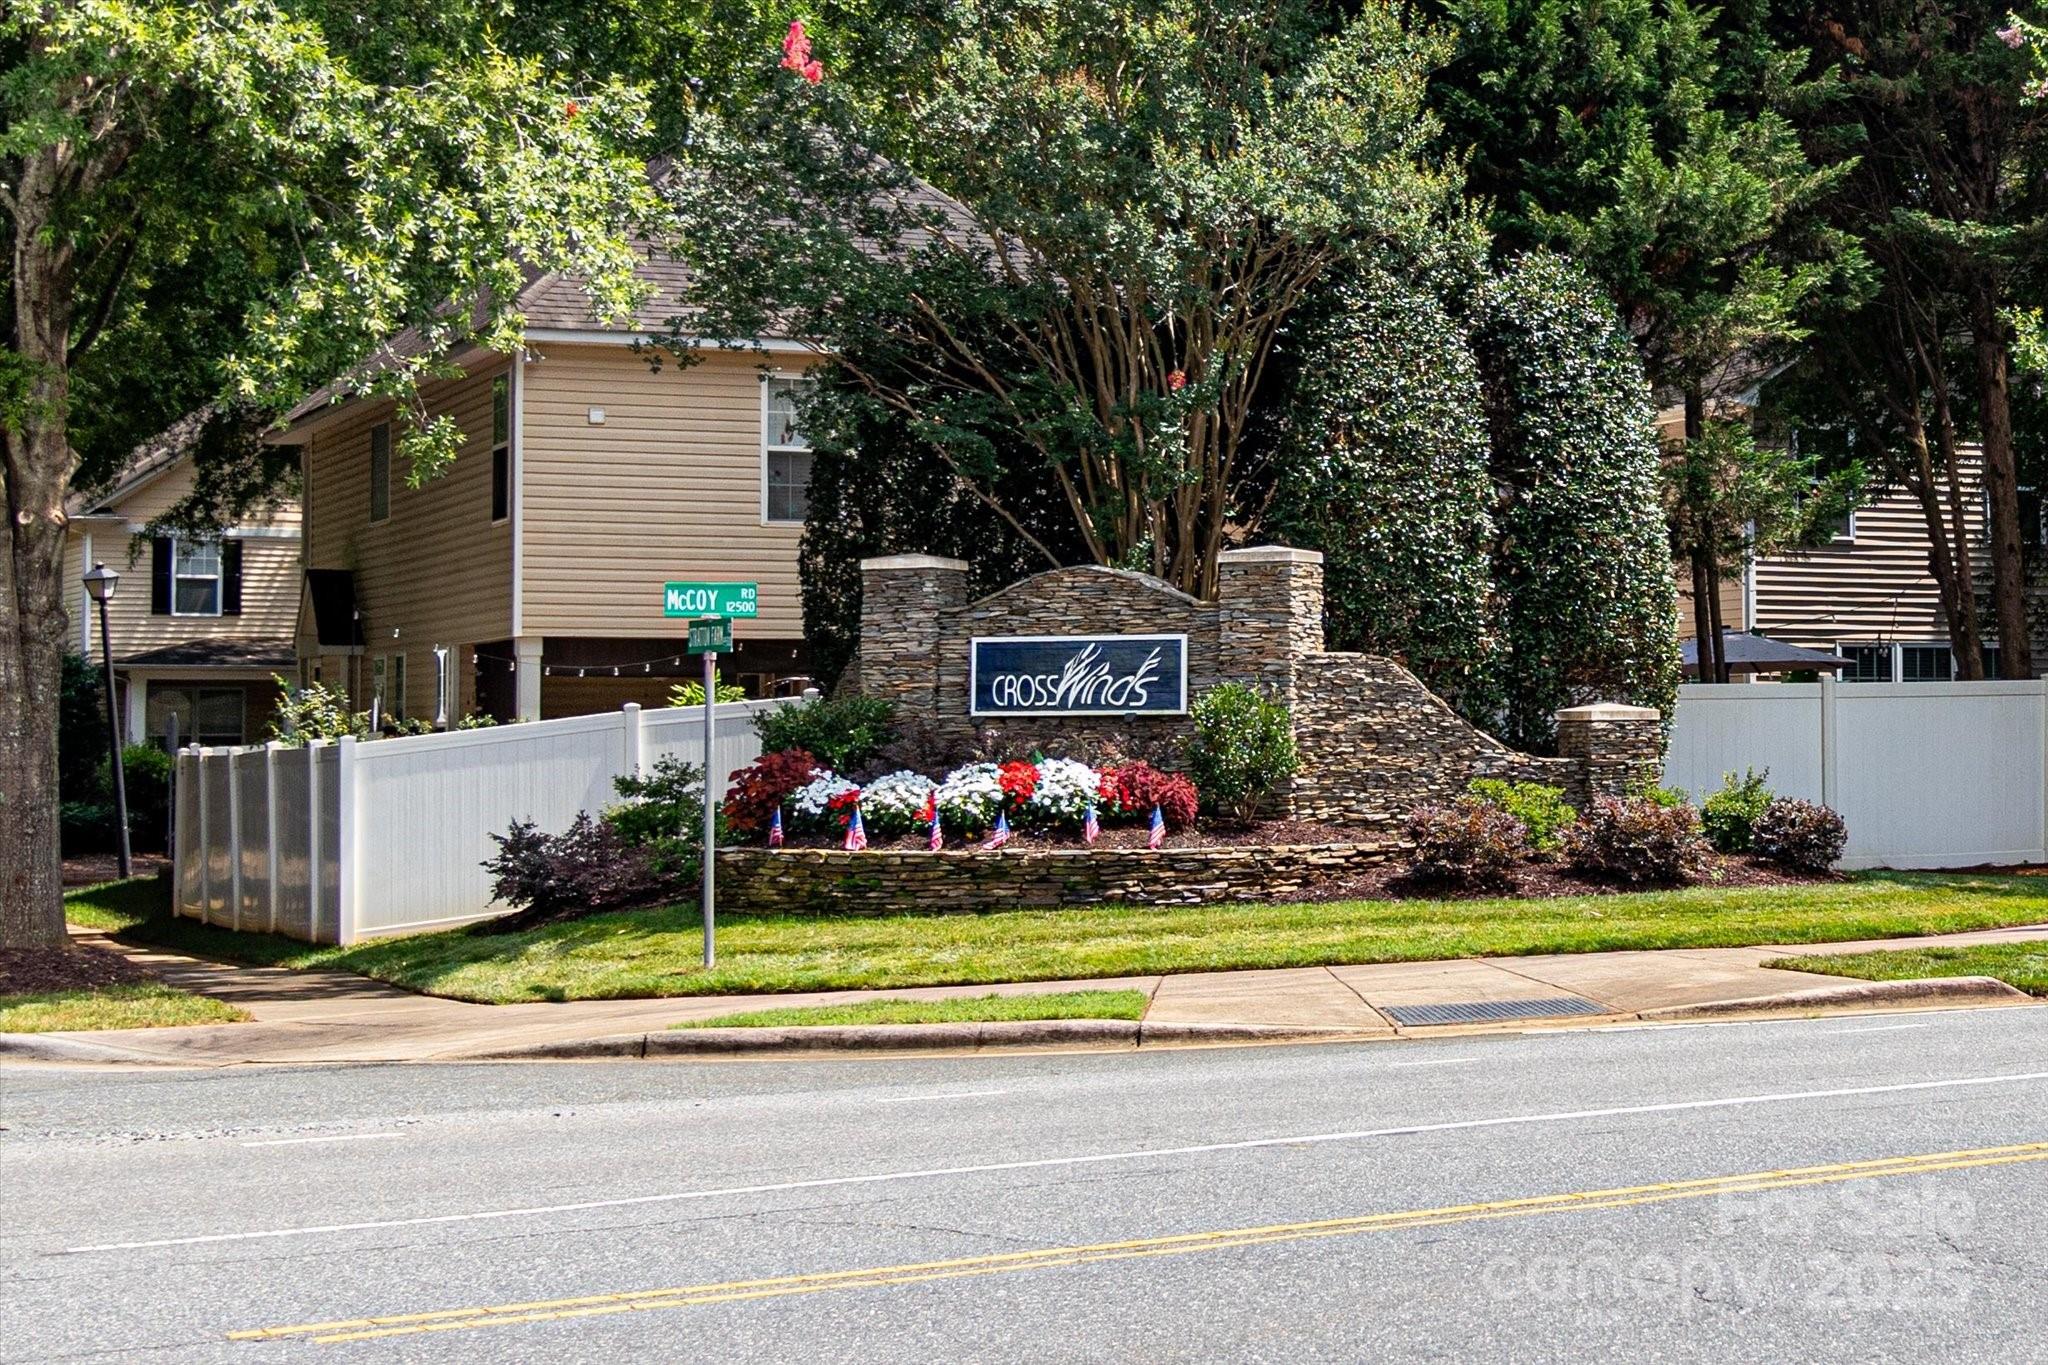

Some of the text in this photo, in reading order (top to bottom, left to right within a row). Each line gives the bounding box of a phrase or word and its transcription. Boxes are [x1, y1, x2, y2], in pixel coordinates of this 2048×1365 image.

[667, 588, 755, 610] McCOY RD
[726, 601, 755, 612] 12500
